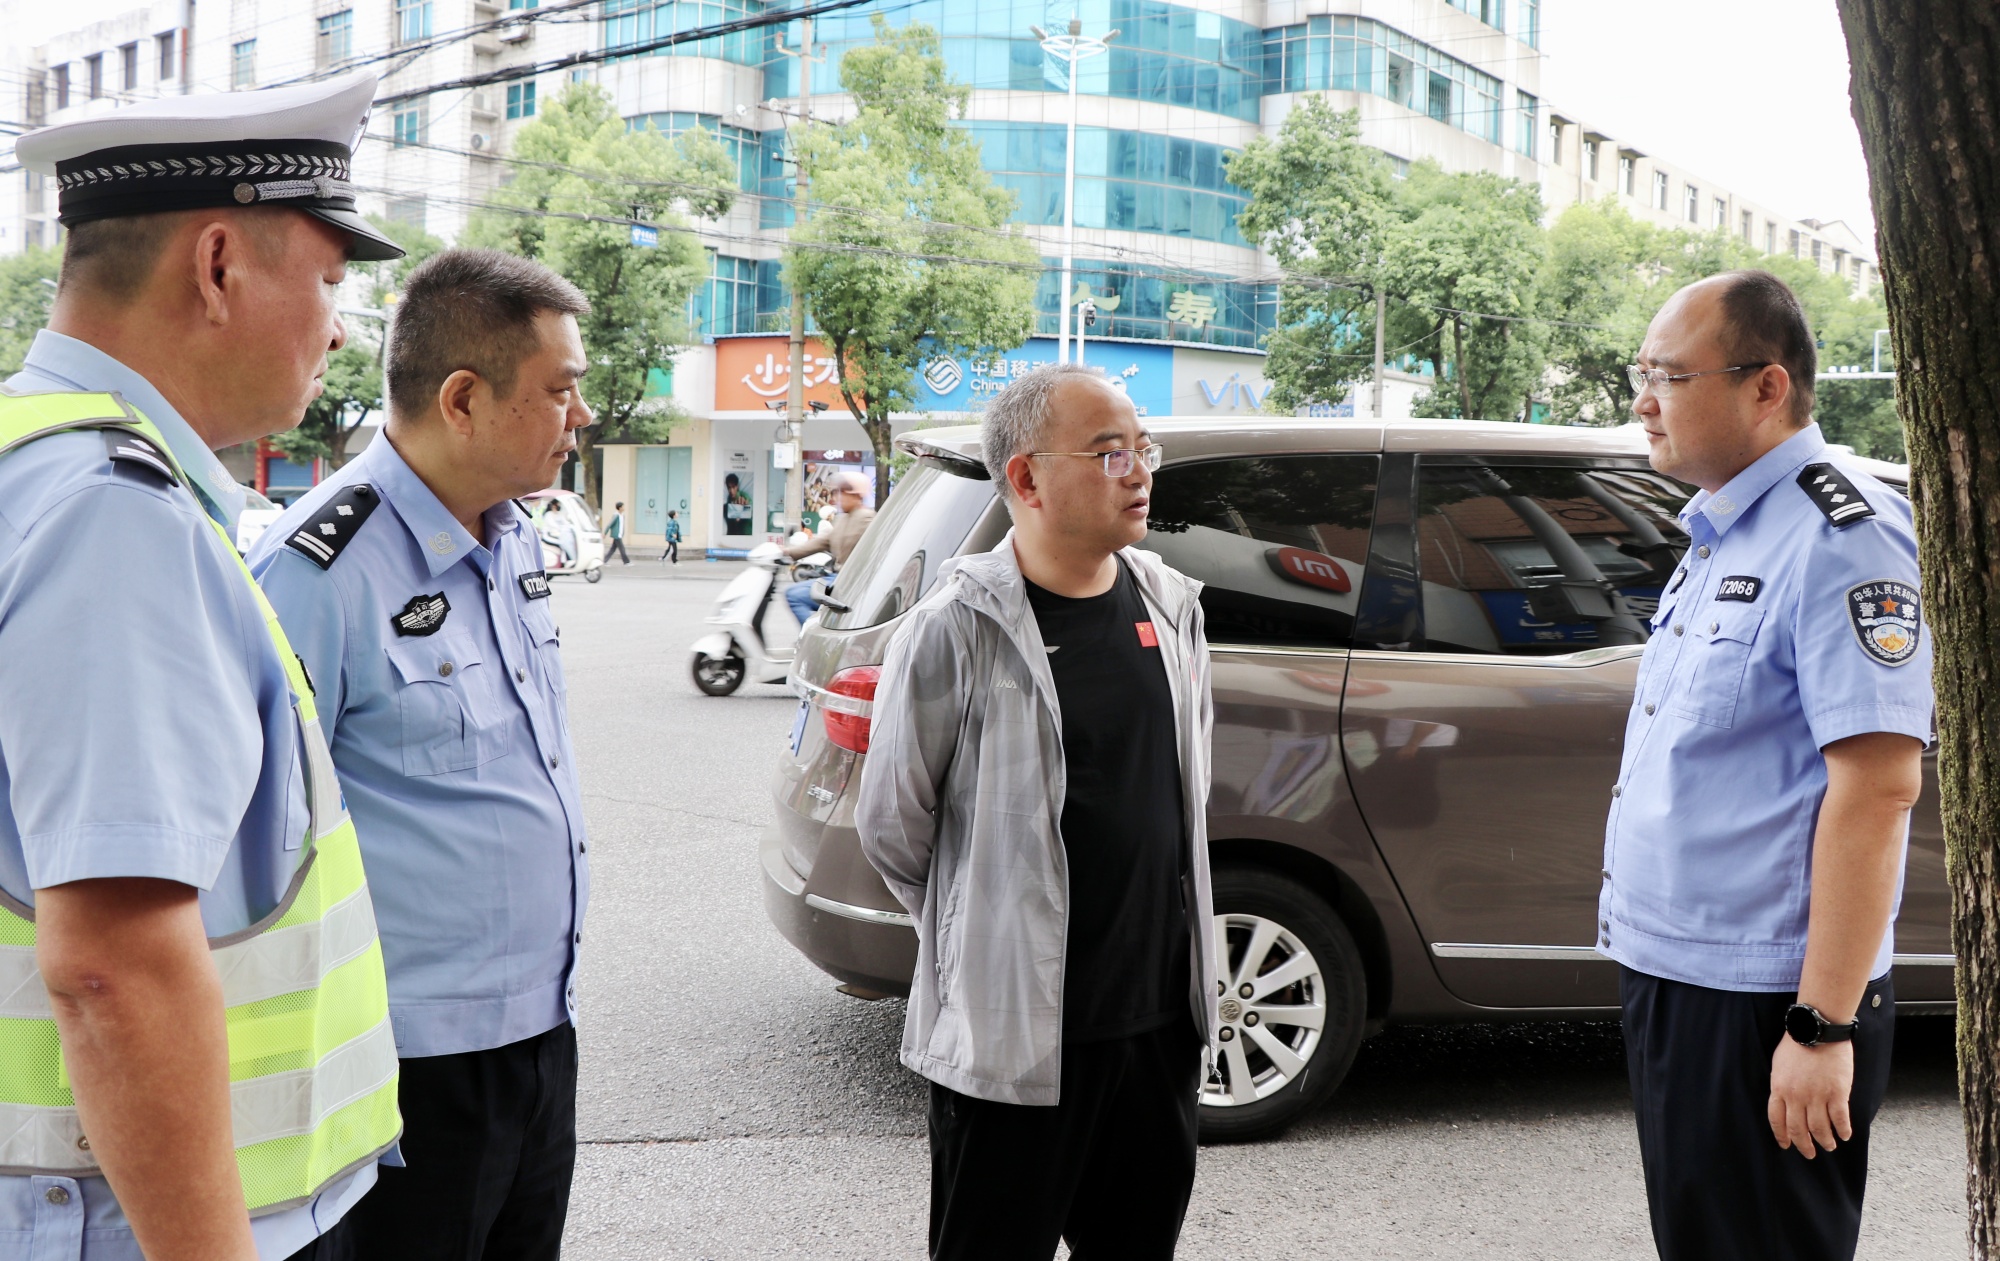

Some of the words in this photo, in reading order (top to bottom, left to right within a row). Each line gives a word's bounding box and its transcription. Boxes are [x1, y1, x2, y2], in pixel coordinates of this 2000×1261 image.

[970, 378, 1005, 391] China
[1197, 372, 1272, 408] viv
[1852, 583, 1918, 606] 中华人民共和国
